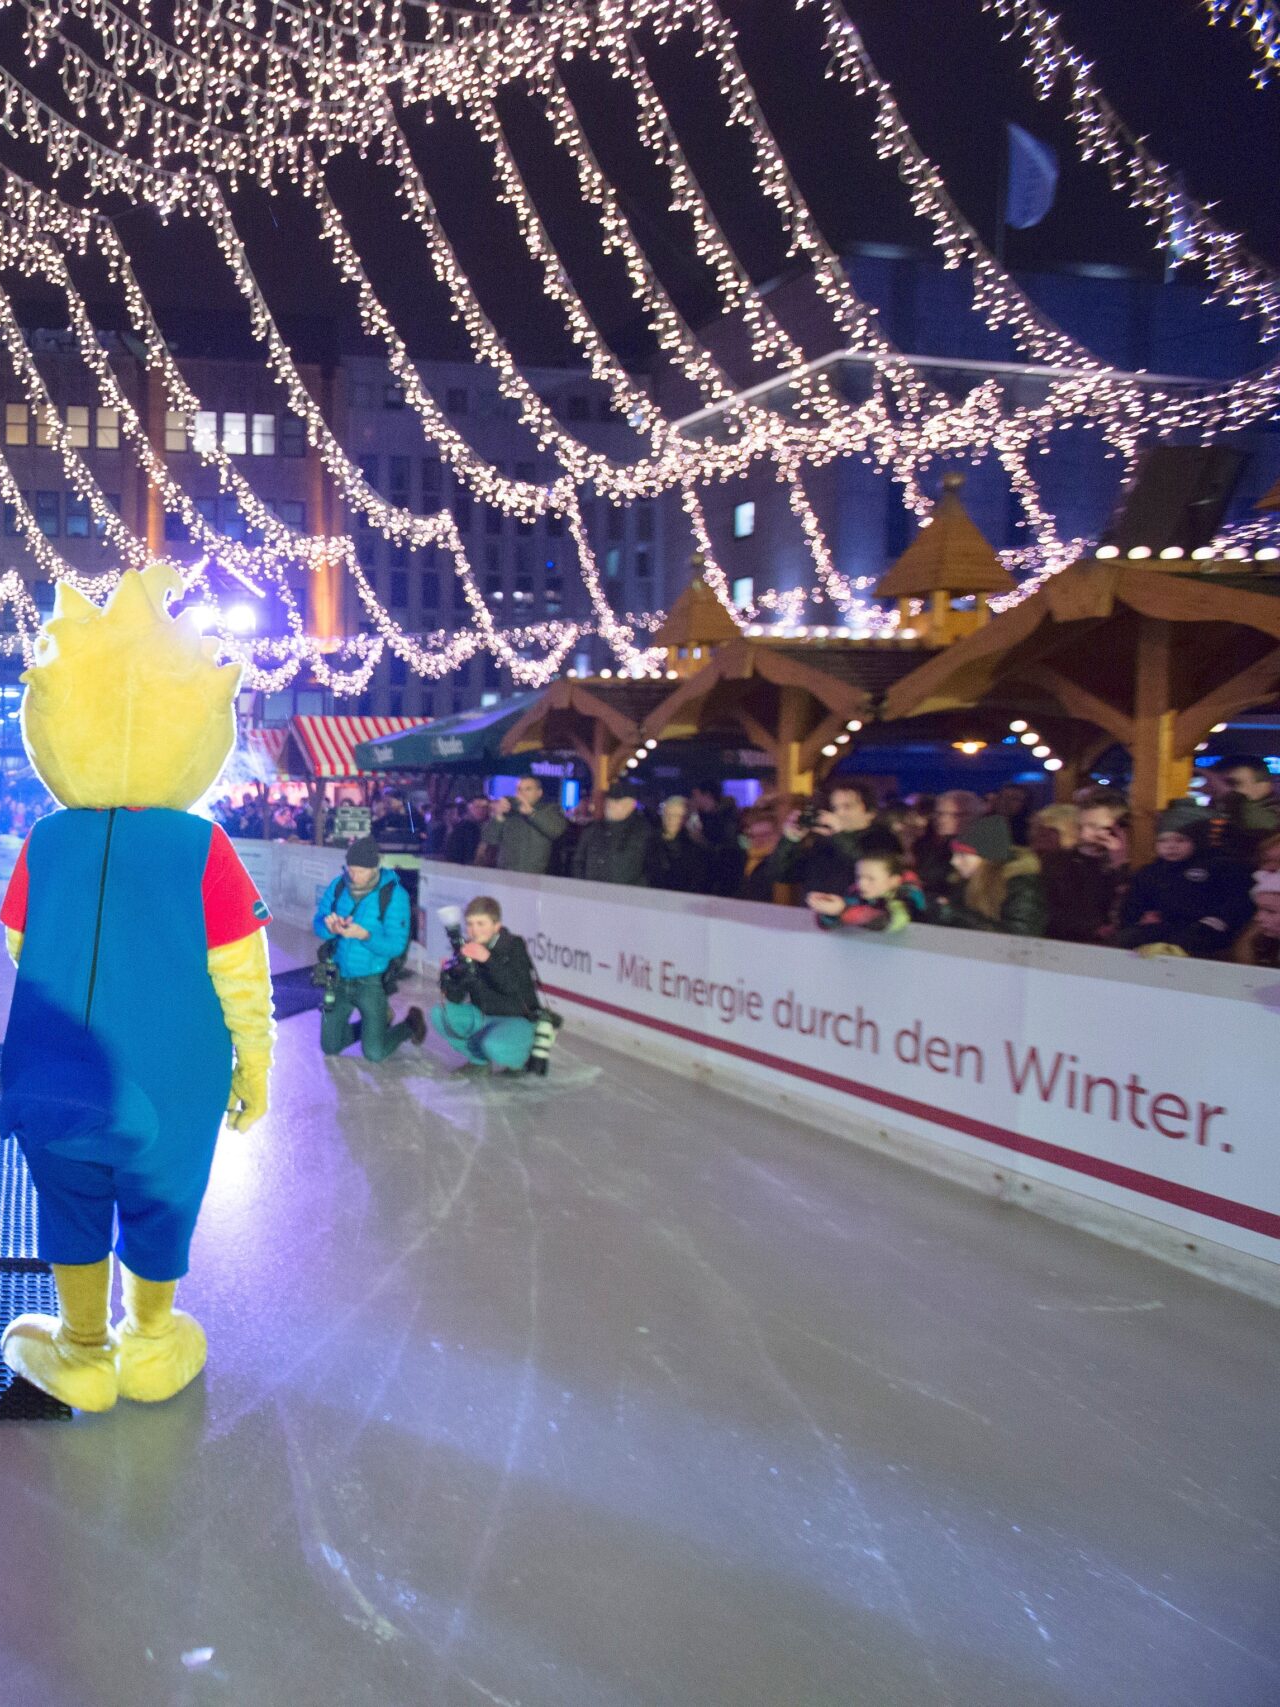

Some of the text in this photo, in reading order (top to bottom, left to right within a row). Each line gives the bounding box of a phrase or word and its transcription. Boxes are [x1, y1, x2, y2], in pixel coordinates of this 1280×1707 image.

[616, 950, 653, 993] Mit
[659, 959, 764, 1024] Energie
[773, 989, 880, 1055] durch
[894, 1019, 985, 1085] den
[1004, 1038, 1235, 1154] Winter.
